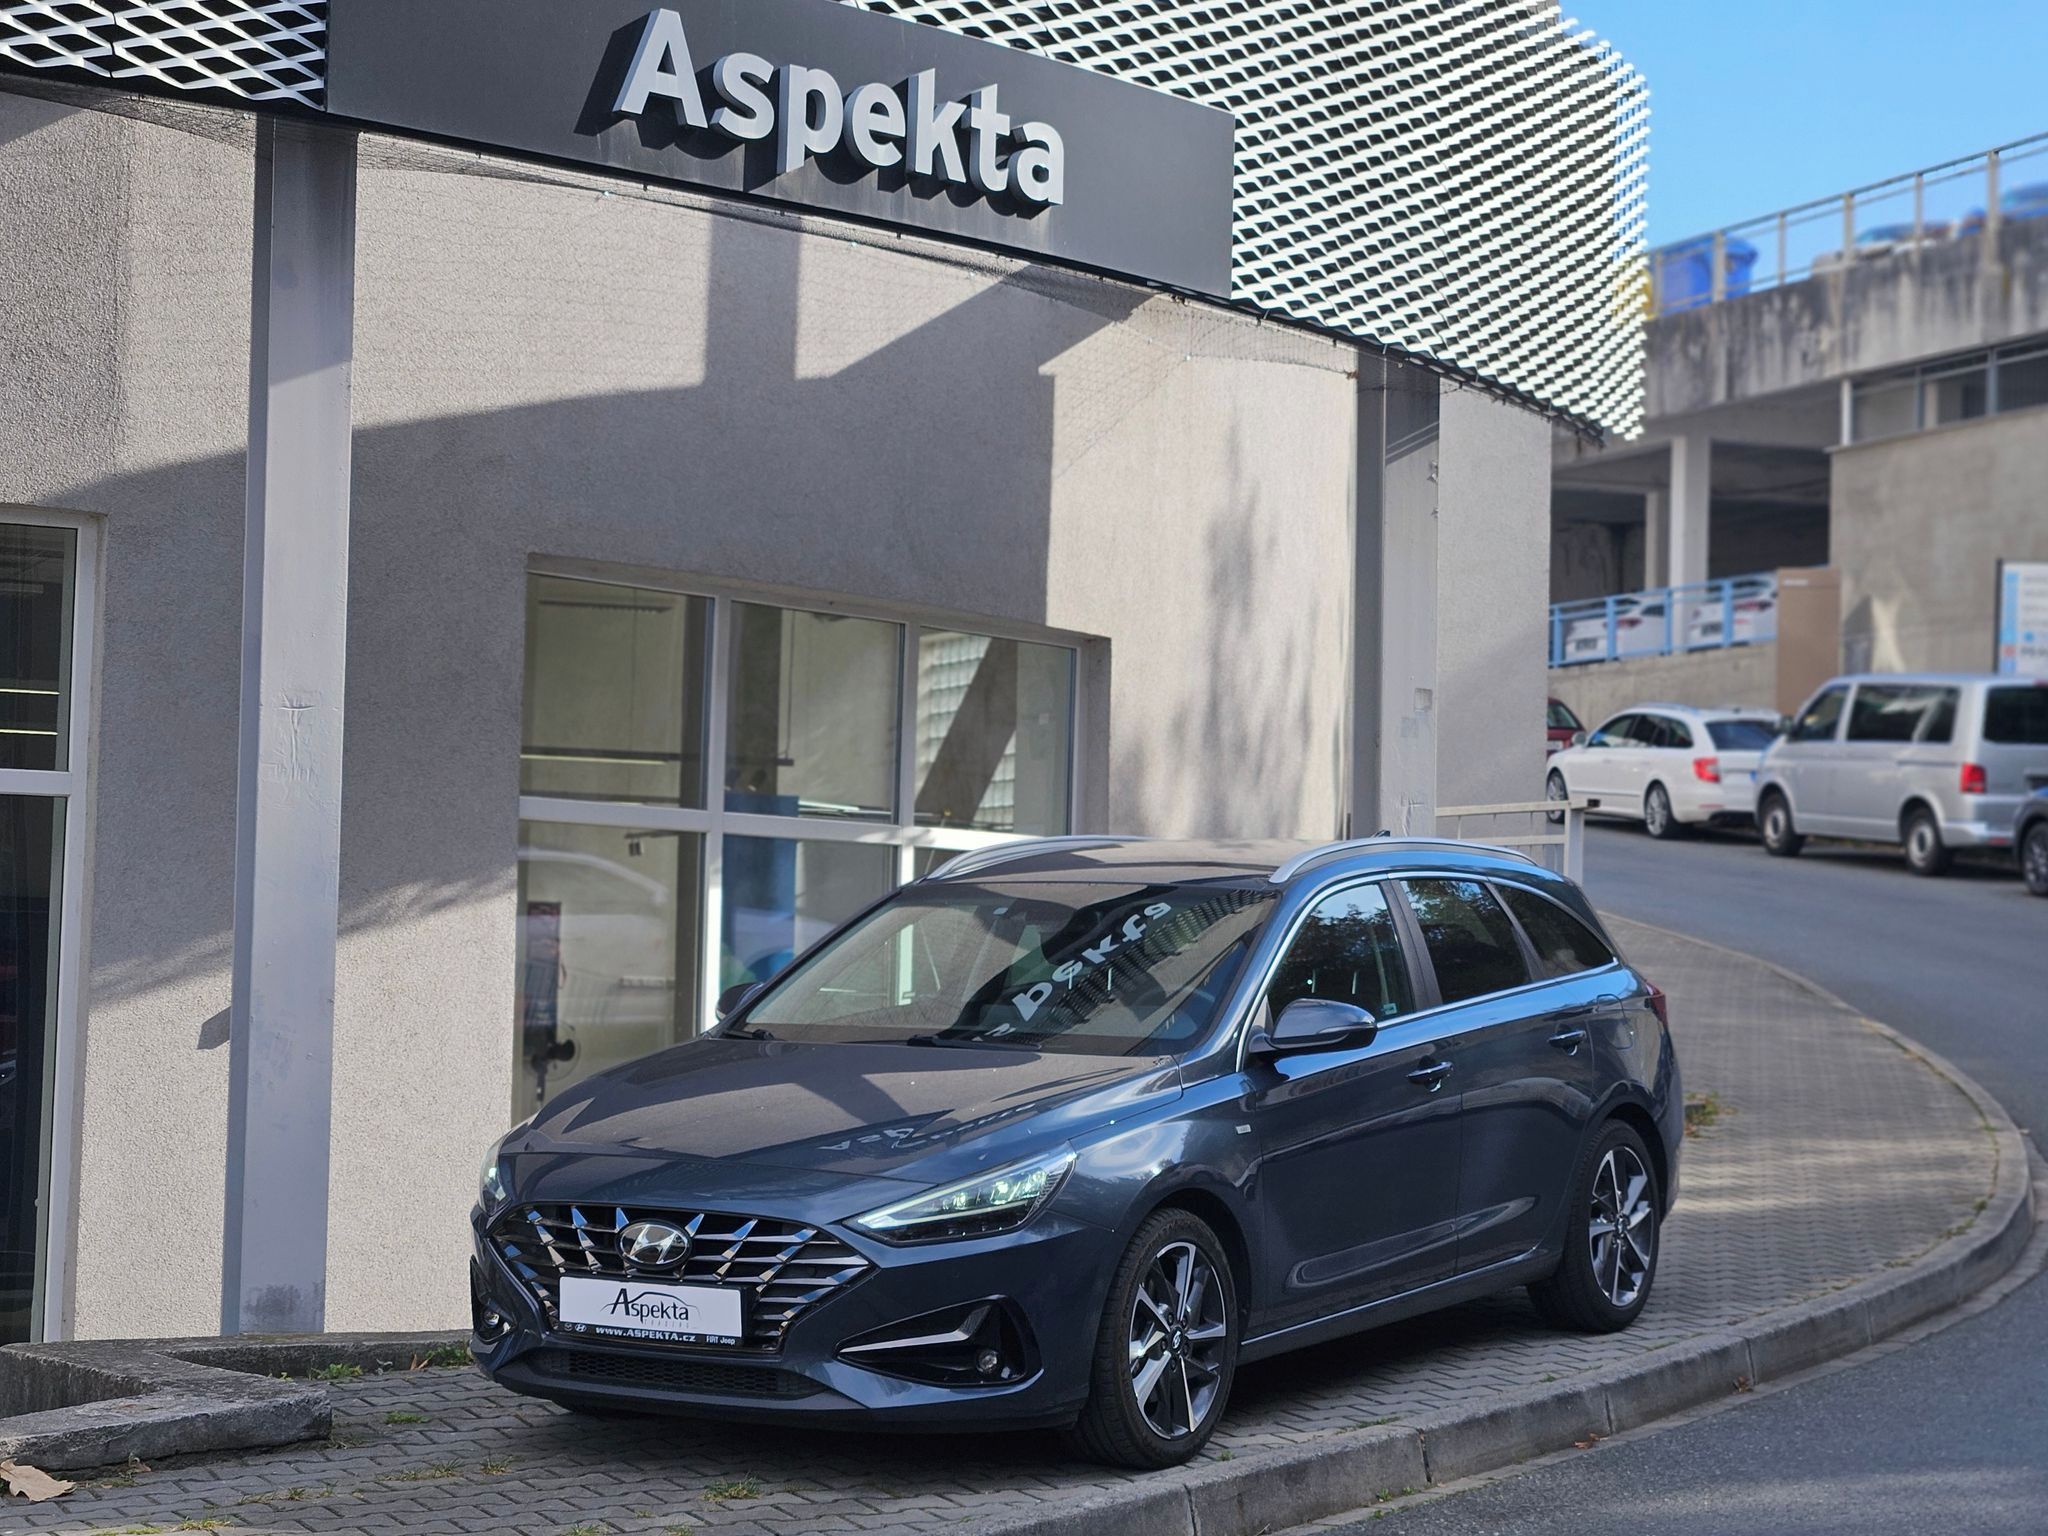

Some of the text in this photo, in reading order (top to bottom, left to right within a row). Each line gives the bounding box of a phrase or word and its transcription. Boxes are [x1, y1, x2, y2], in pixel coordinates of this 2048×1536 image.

[612, 8, 1065, 206] Aspekta
[610, 1287, 689, 1324] Aspekta
[595, 1326, 697, 1342] www.ASPEKTA.cz
[720, 1336, 736, 1346] Jeep
